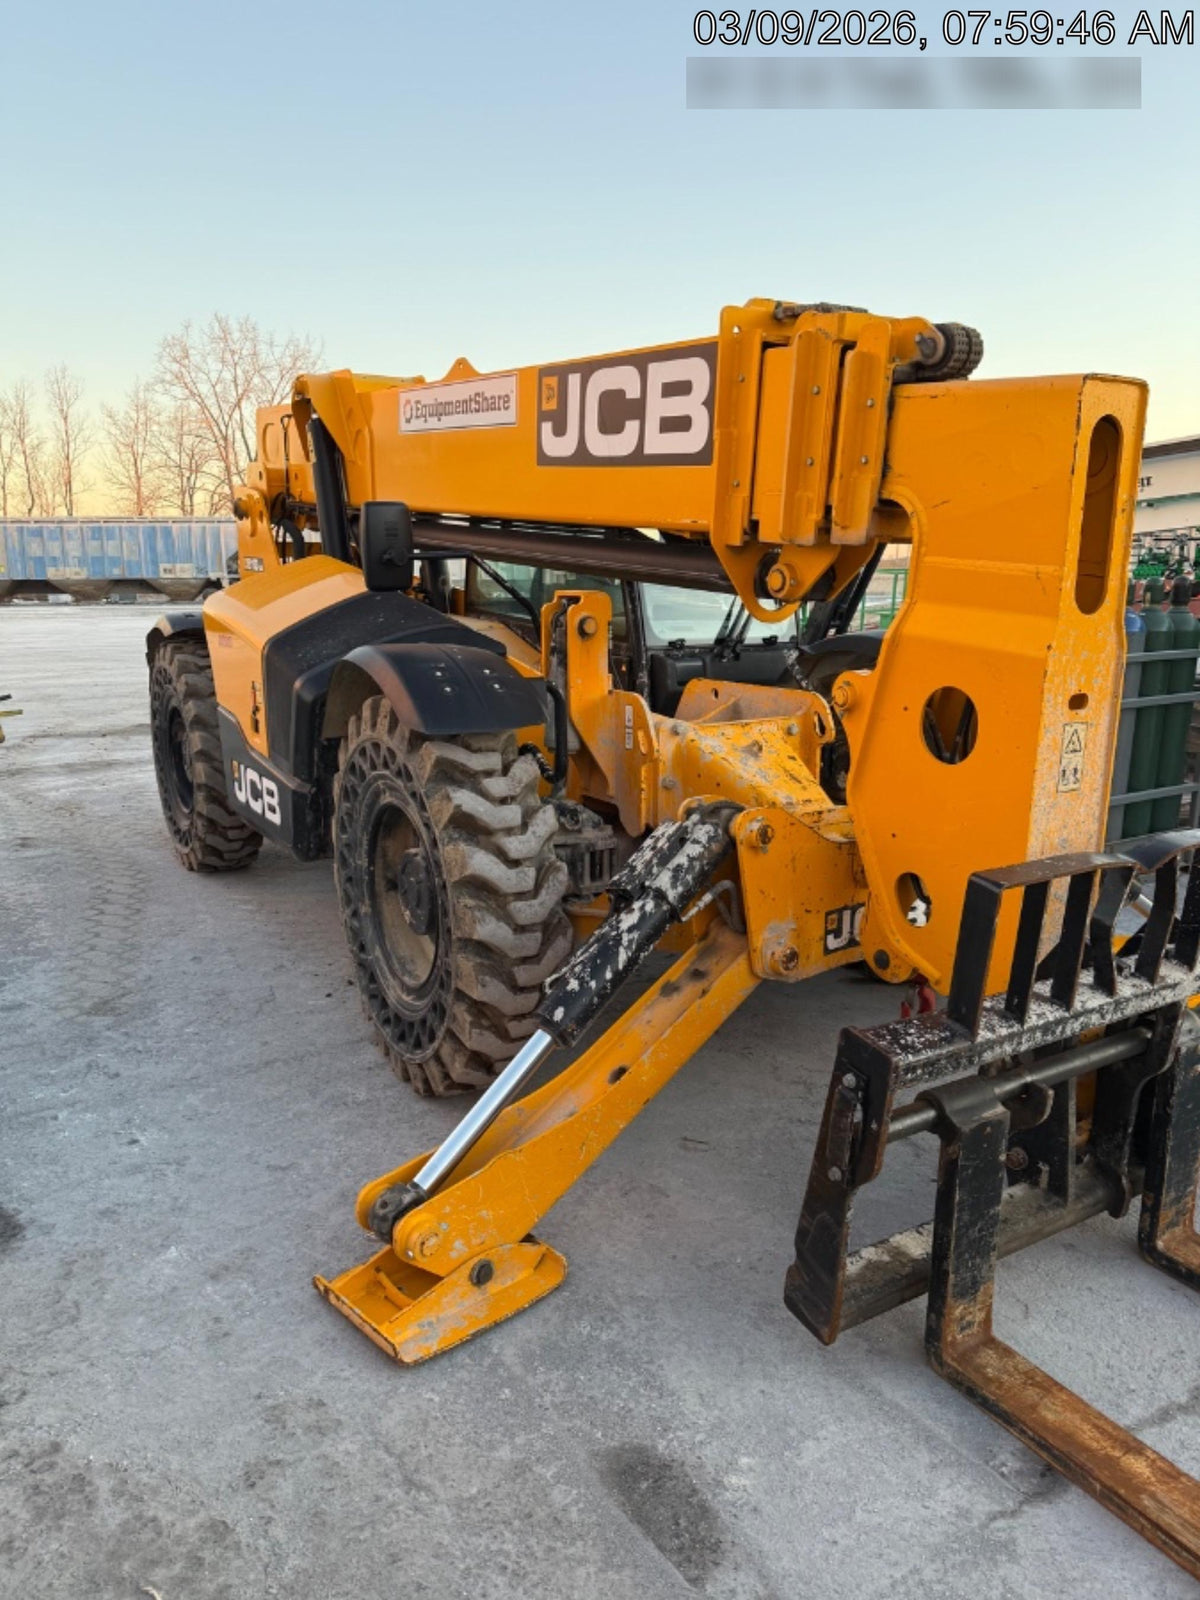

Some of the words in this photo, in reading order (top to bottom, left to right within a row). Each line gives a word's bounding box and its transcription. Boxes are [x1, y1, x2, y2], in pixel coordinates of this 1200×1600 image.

[414, 390, 511, 423] EquipmentShare
[541, 356, 710, 458] JCB
[234, 763, 281, 826] JCB
